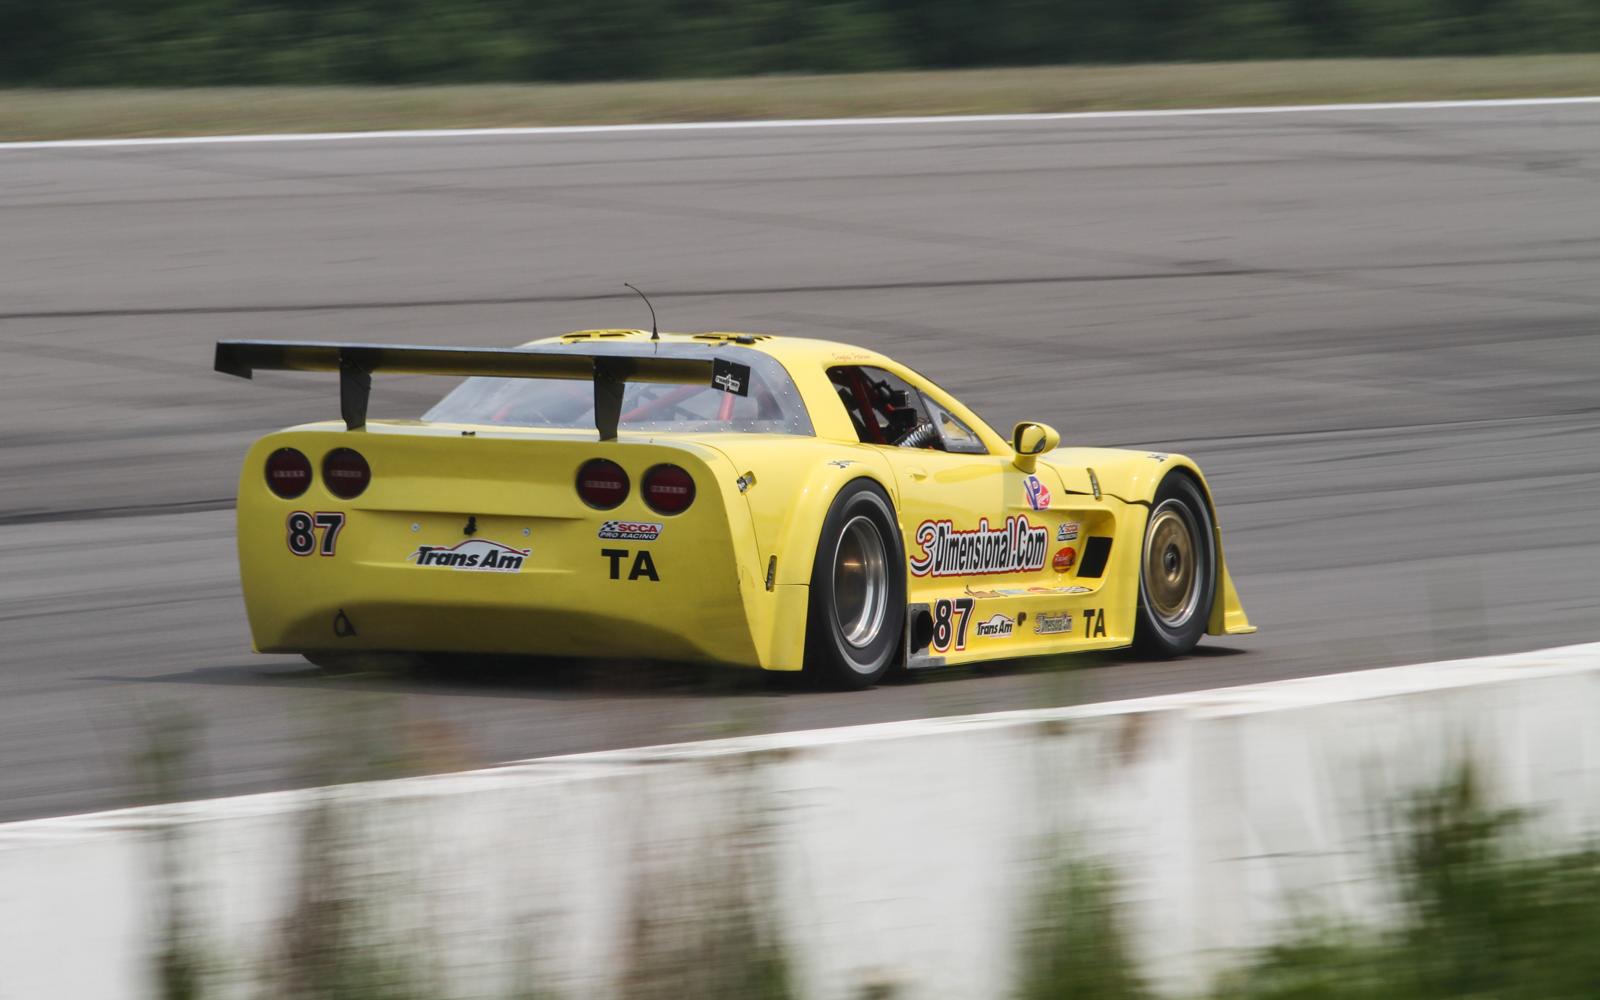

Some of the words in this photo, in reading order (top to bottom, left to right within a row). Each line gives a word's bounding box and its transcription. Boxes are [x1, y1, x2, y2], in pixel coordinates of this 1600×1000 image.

[287, 511, 345, 557] 87
[600, 531, 619, 539] PRO
[620, 532, 656, 540] RACING
[617, 523, 658, 533] SCCA
[416, 546, 482, 567] Trans
[480, 549, 523, 569] Am
[601, 548, 660, 582] TA
[932, 599, 975, 651] 87
[977, 621, 999, 636] Trans
[999, 619, 1013, 634] Am
[1083, 608, 1107, 639] TA
